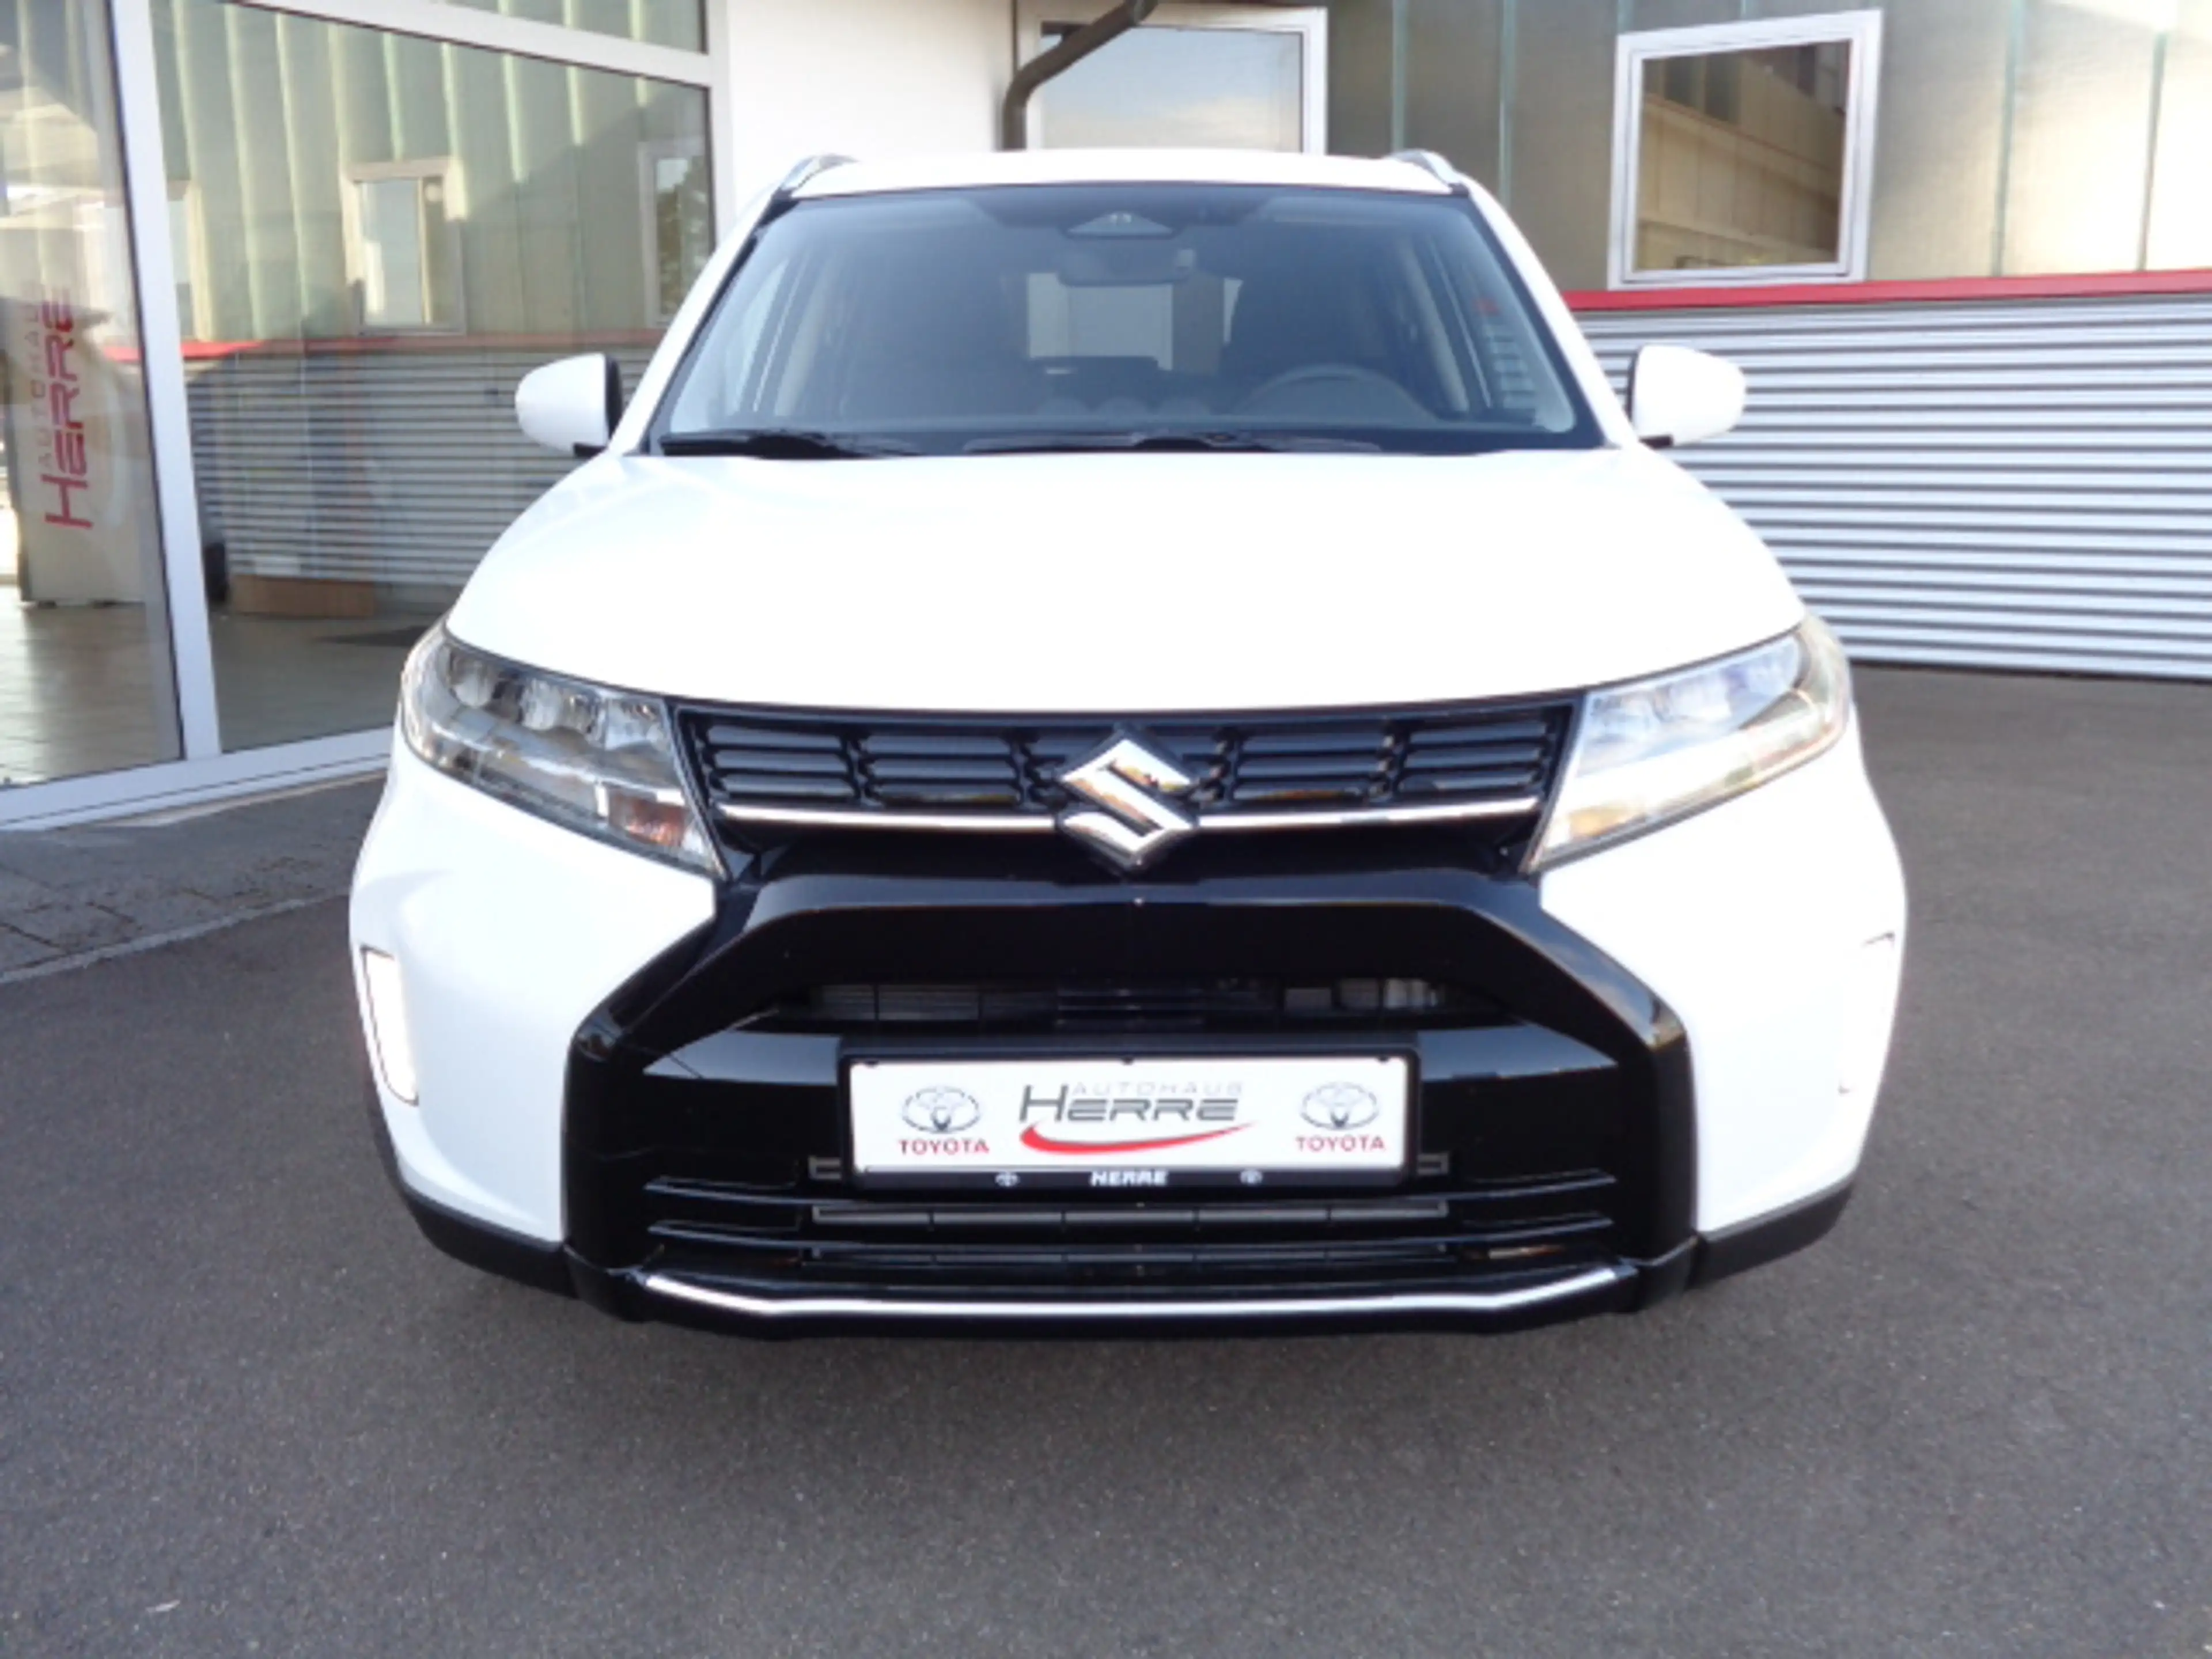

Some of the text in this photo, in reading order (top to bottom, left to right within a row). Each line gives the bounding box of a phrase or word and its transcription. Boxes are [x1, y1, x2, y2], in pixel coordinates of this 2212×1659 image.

[39, 286, 93, 530] HERRE
[1071, 1082, 1243, 1096] AUTOHAUS
[1019, 1084, 1239, 1122] HERRE
[899, 1138, 990, 1155] TOYOTA
[1295, 1135, 1386, 1152] TOYOTA
[1090, 1171, 1169, 1186] HERRE
